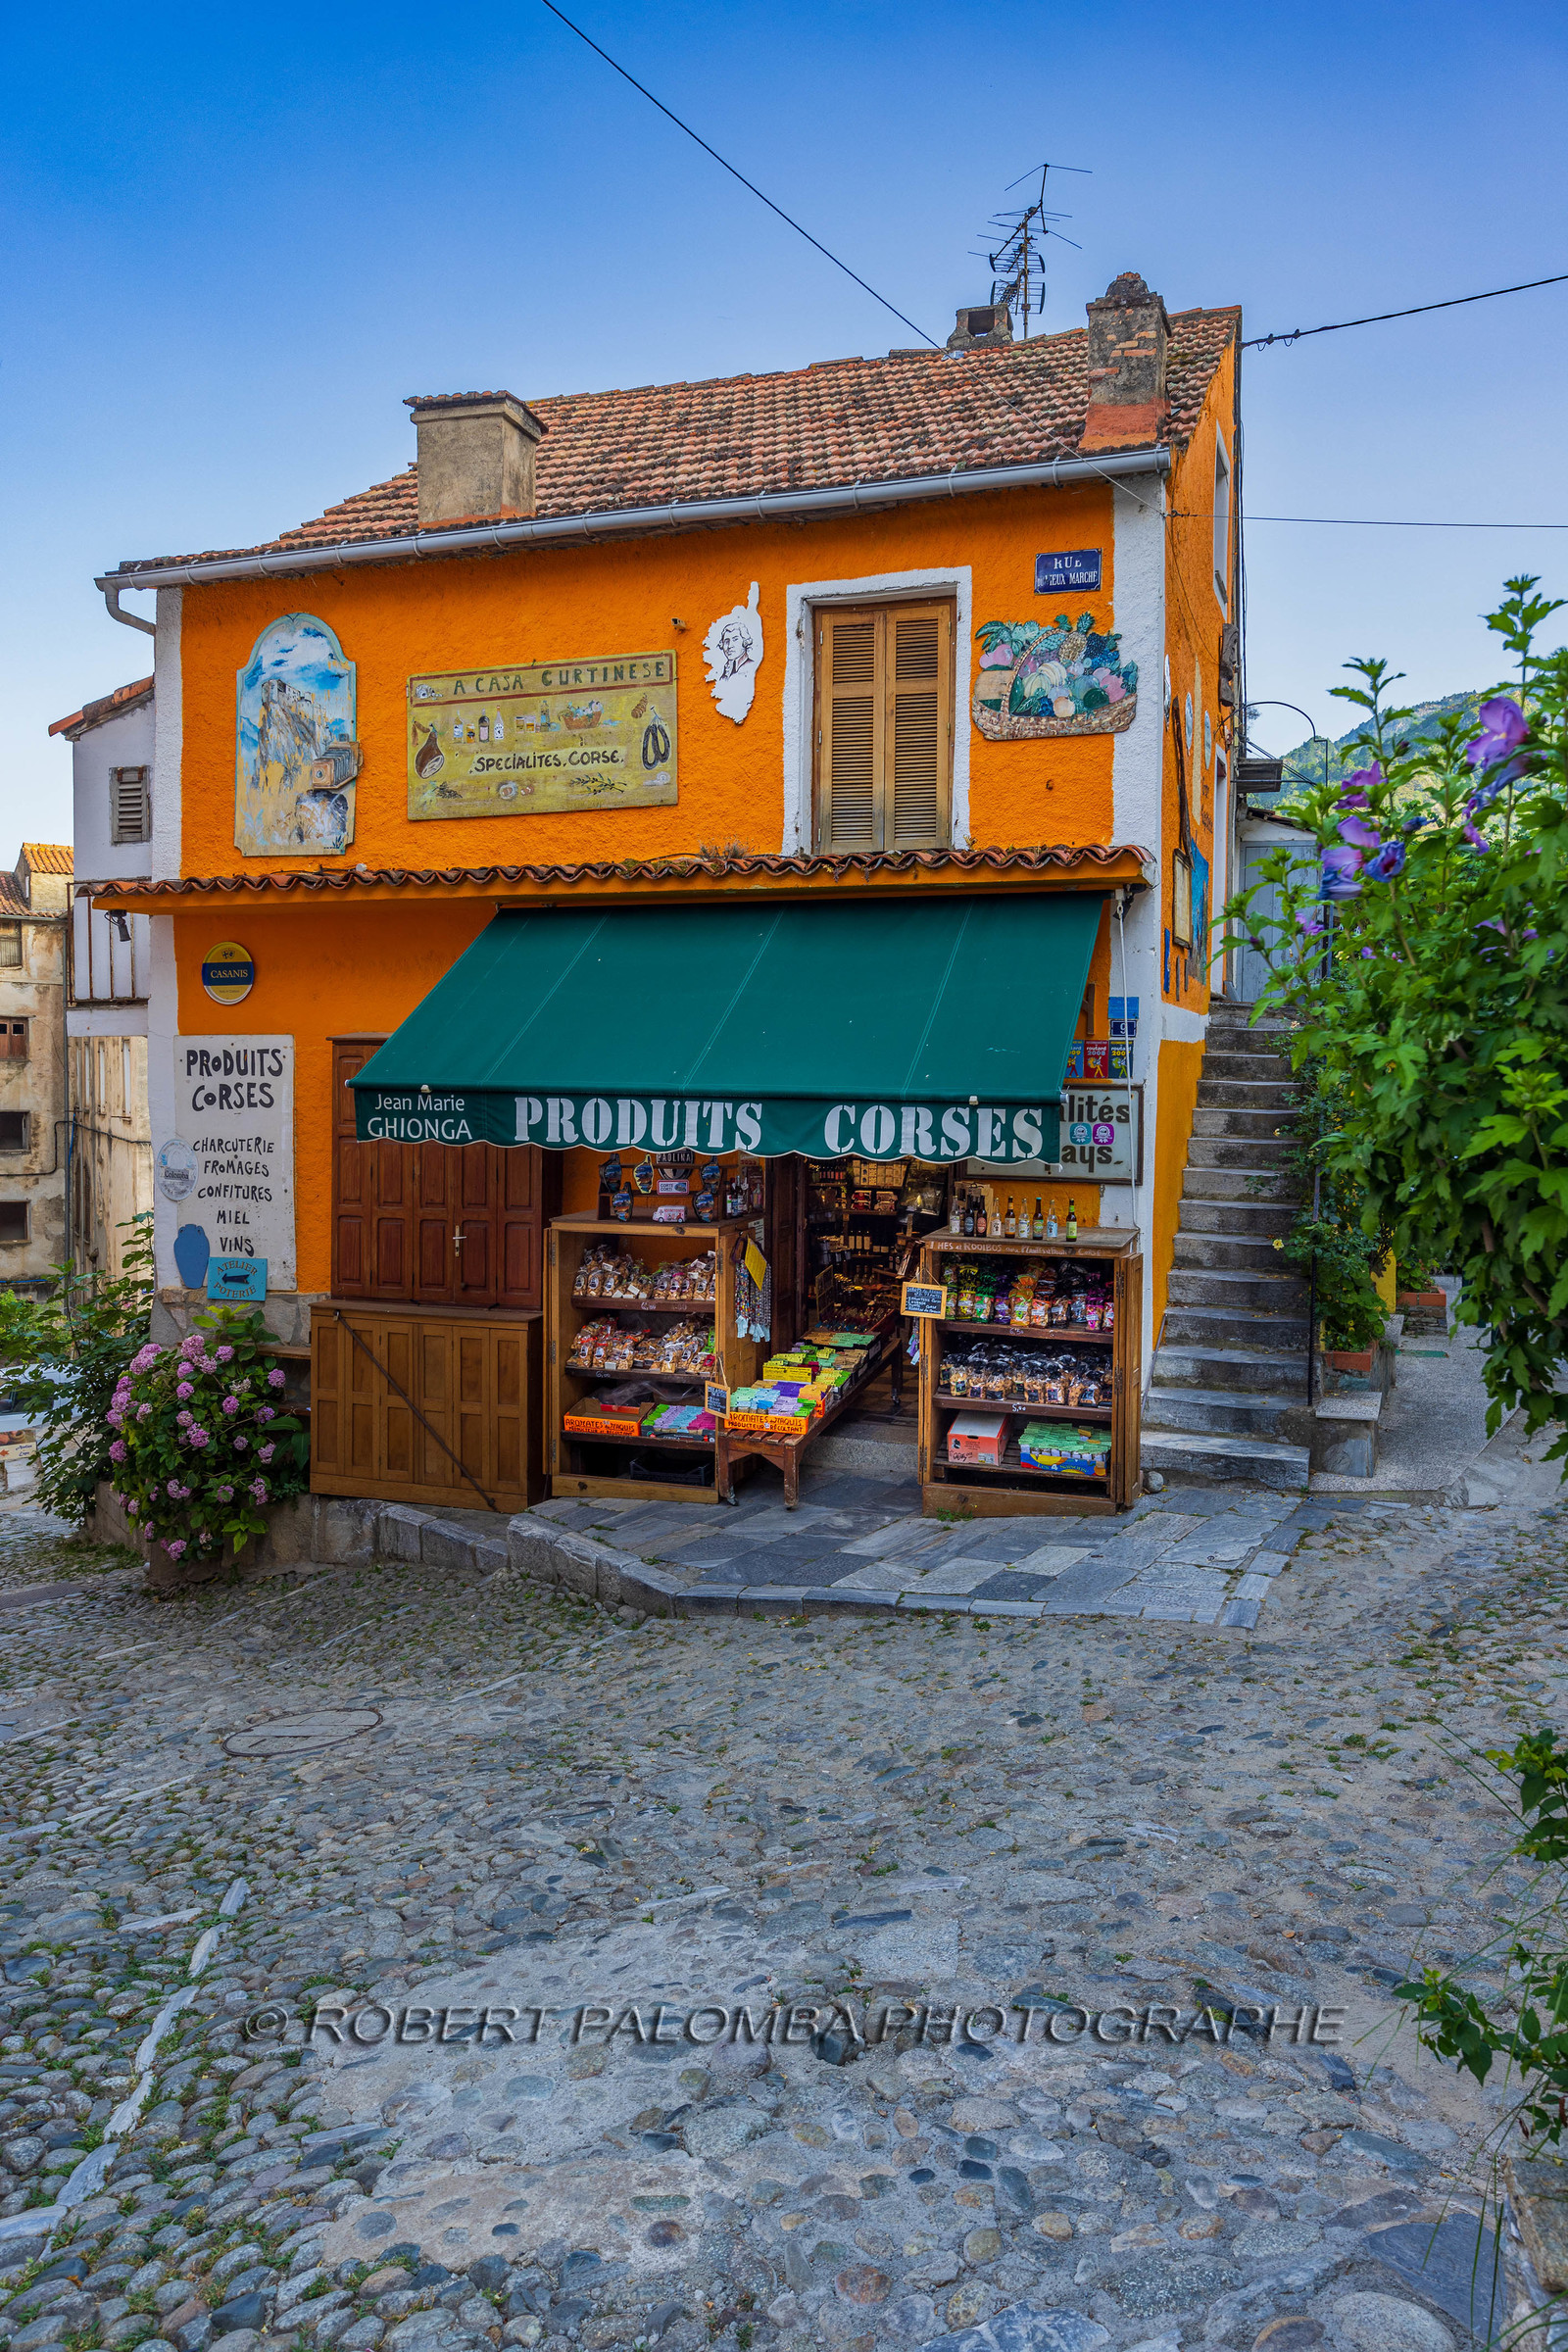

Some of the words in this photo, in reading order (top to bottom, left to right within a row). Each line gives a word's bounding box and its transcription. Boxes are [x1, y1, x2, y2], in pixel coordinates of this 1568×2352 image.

[453, 680, 466, 695] A
[475, 675, 524, 692] CASA
[541, 662, 664, 686] CURTINESE
[210, 969, 249, 979] CASANIS
[1119, 1023, 1128, 1035] 9
[186, 1049, 283, 1077] PRODUITS
[192, 1082, 274, 1111] CORSES
[375, 1094, 412, 1110] Jean
[417, 1095, 466, 1112] Marie
[368, 1117, 472, 1140] GHIONGA
[514, 1097, 761, 1152] PRODUITS
[824, 1104, 1043, 1158] CORSES
[193, 1137, 274, 1155] CHARCUTERIE
[658, 1152, 691, 1162] PAOLINA
[204, 1159, 270, 1177] FROMAGES
[197, 1183, 272, 1202] CONFITURES
[217, 1209, 250, 1225] MIEL
[220, 1236, 255, 1257] VINS
[964, 1243, 1002, 1252] ROOIBOS
[217, 1260, 258, 1275] ATELIER
[214, 1282, 257, 1298] POTERIE
